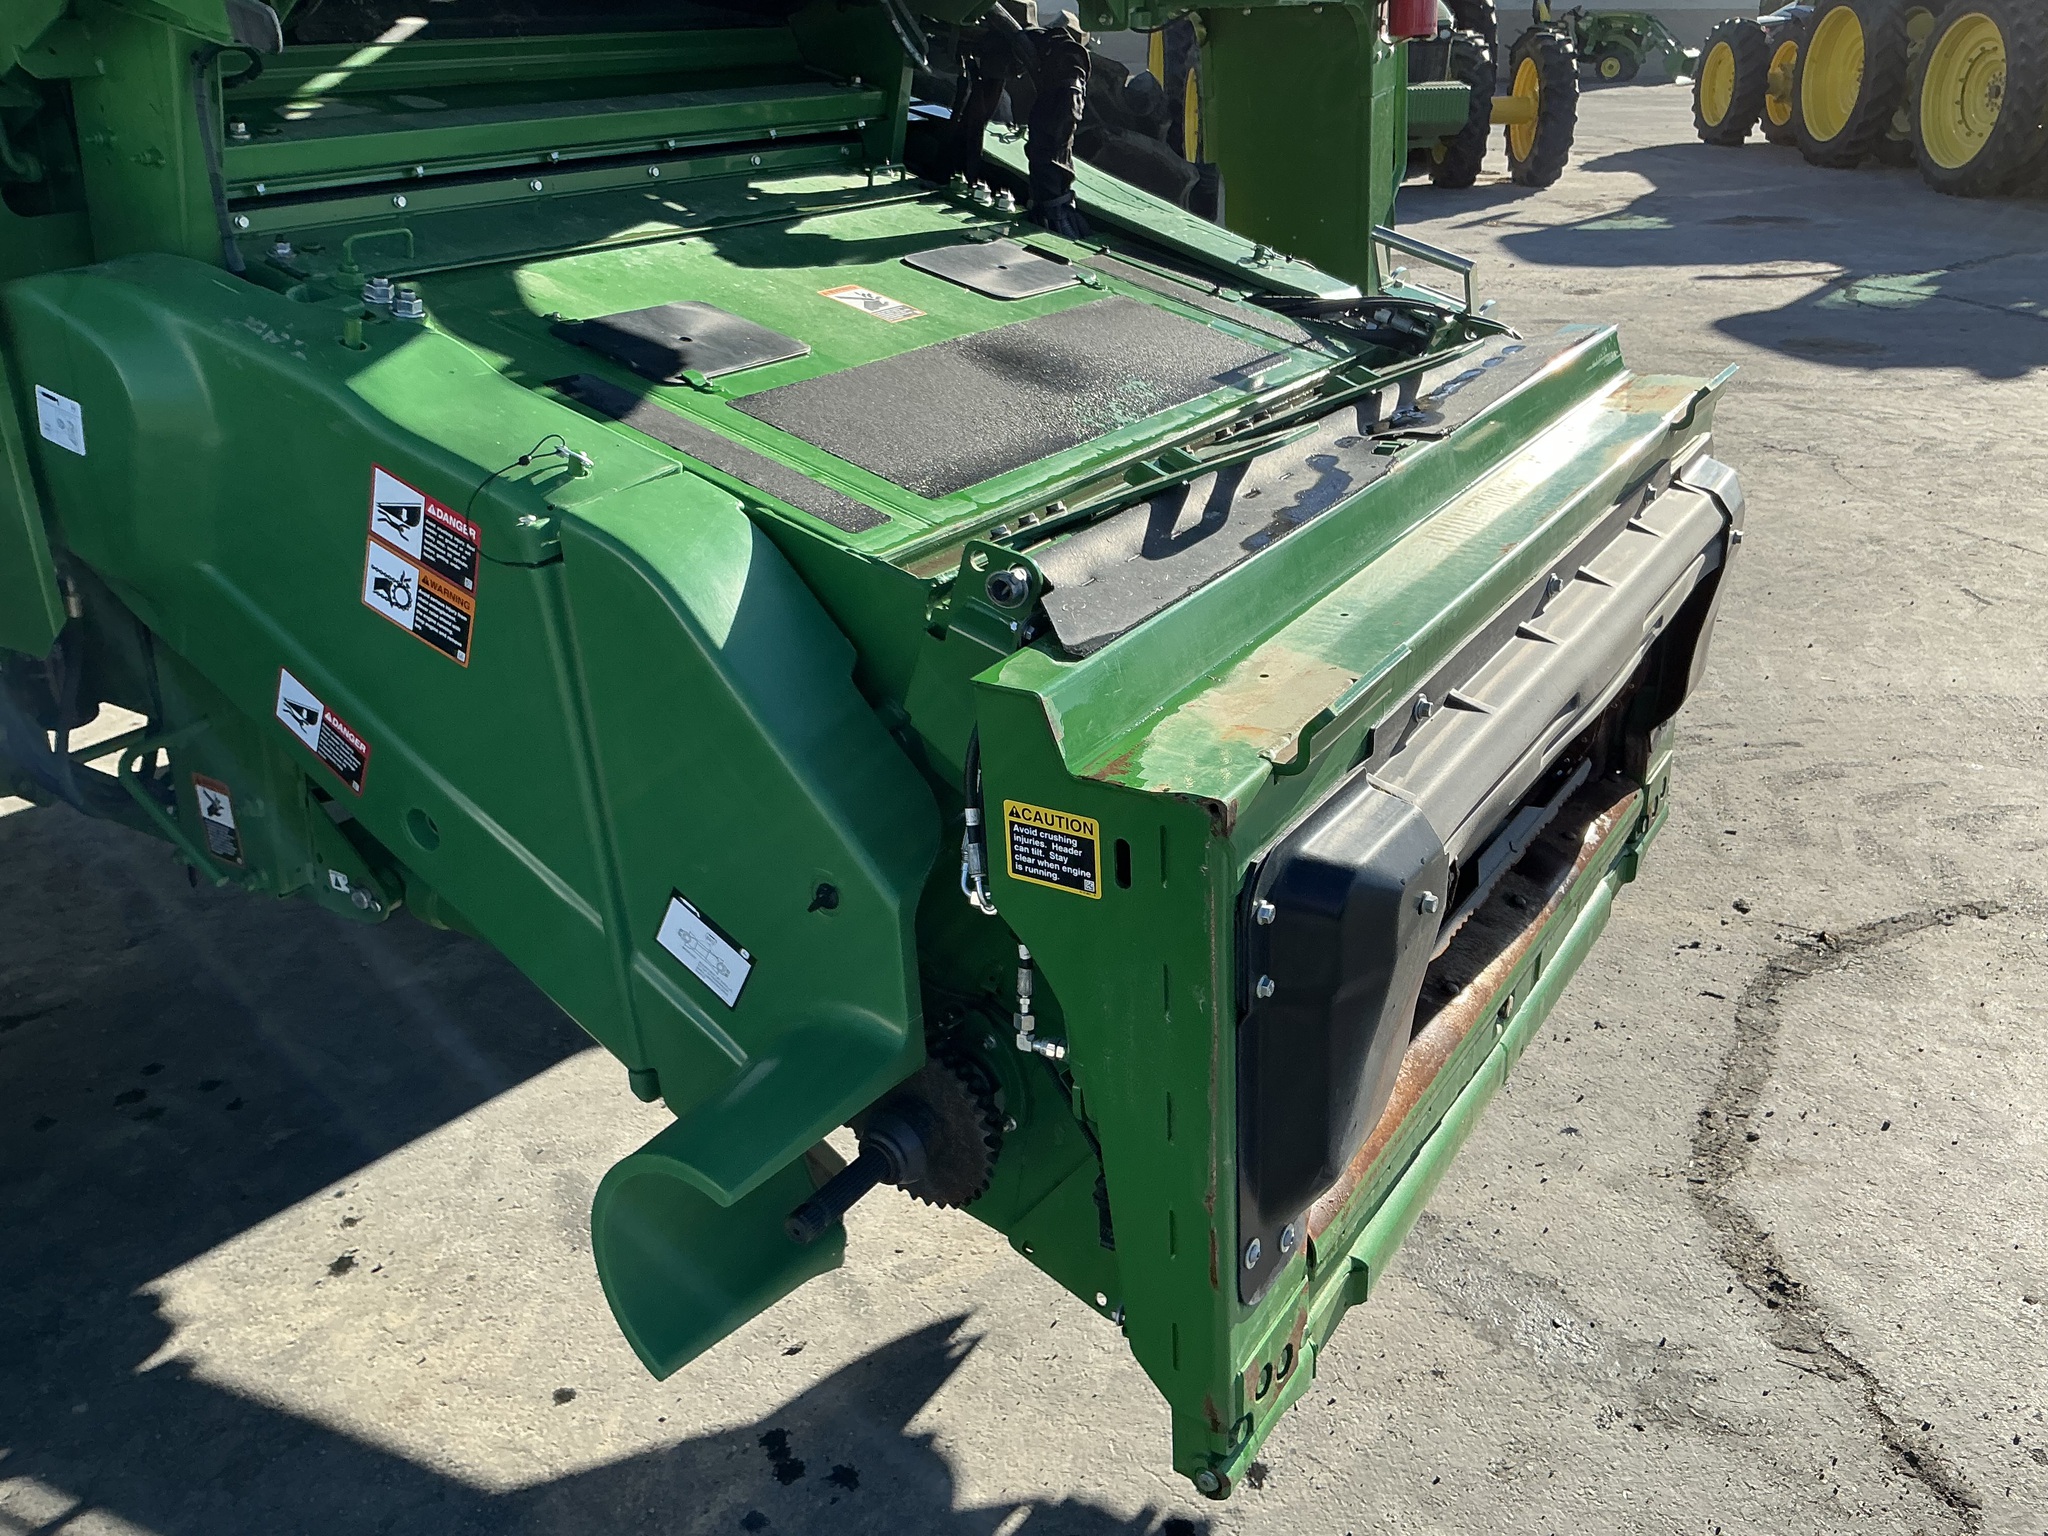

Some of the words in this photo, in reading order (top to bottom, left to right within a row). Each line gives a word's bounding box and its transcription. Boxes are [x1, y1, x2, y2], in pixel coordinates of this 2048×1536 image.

[436, 508, 476, 540] DANGER
[430, 580, 470, 610] WARNING
[332, 717, 366, 753] DANGER
[1022, 808, 1093, 835] CAUTION
[1013, 824, 1037, 836] Avoid
[1039, 831, 1077, 848] crushing
[1013, 834, 1047, 848] injuries.
[1052, 843, 1082, 856] Header
[1014, 845, 1029, 854] can
[1031, 848, 1045, 857] tilt.
[1049, 852, 1068, 864] Stay
[1014, 854, 1035, 864] clear
[1037, 859, 1060, 870] when
[1062, 865, 1091, 878] engine
[1015, 862, 1023, 870] is
[1025, 866, 1060, 881] running.
